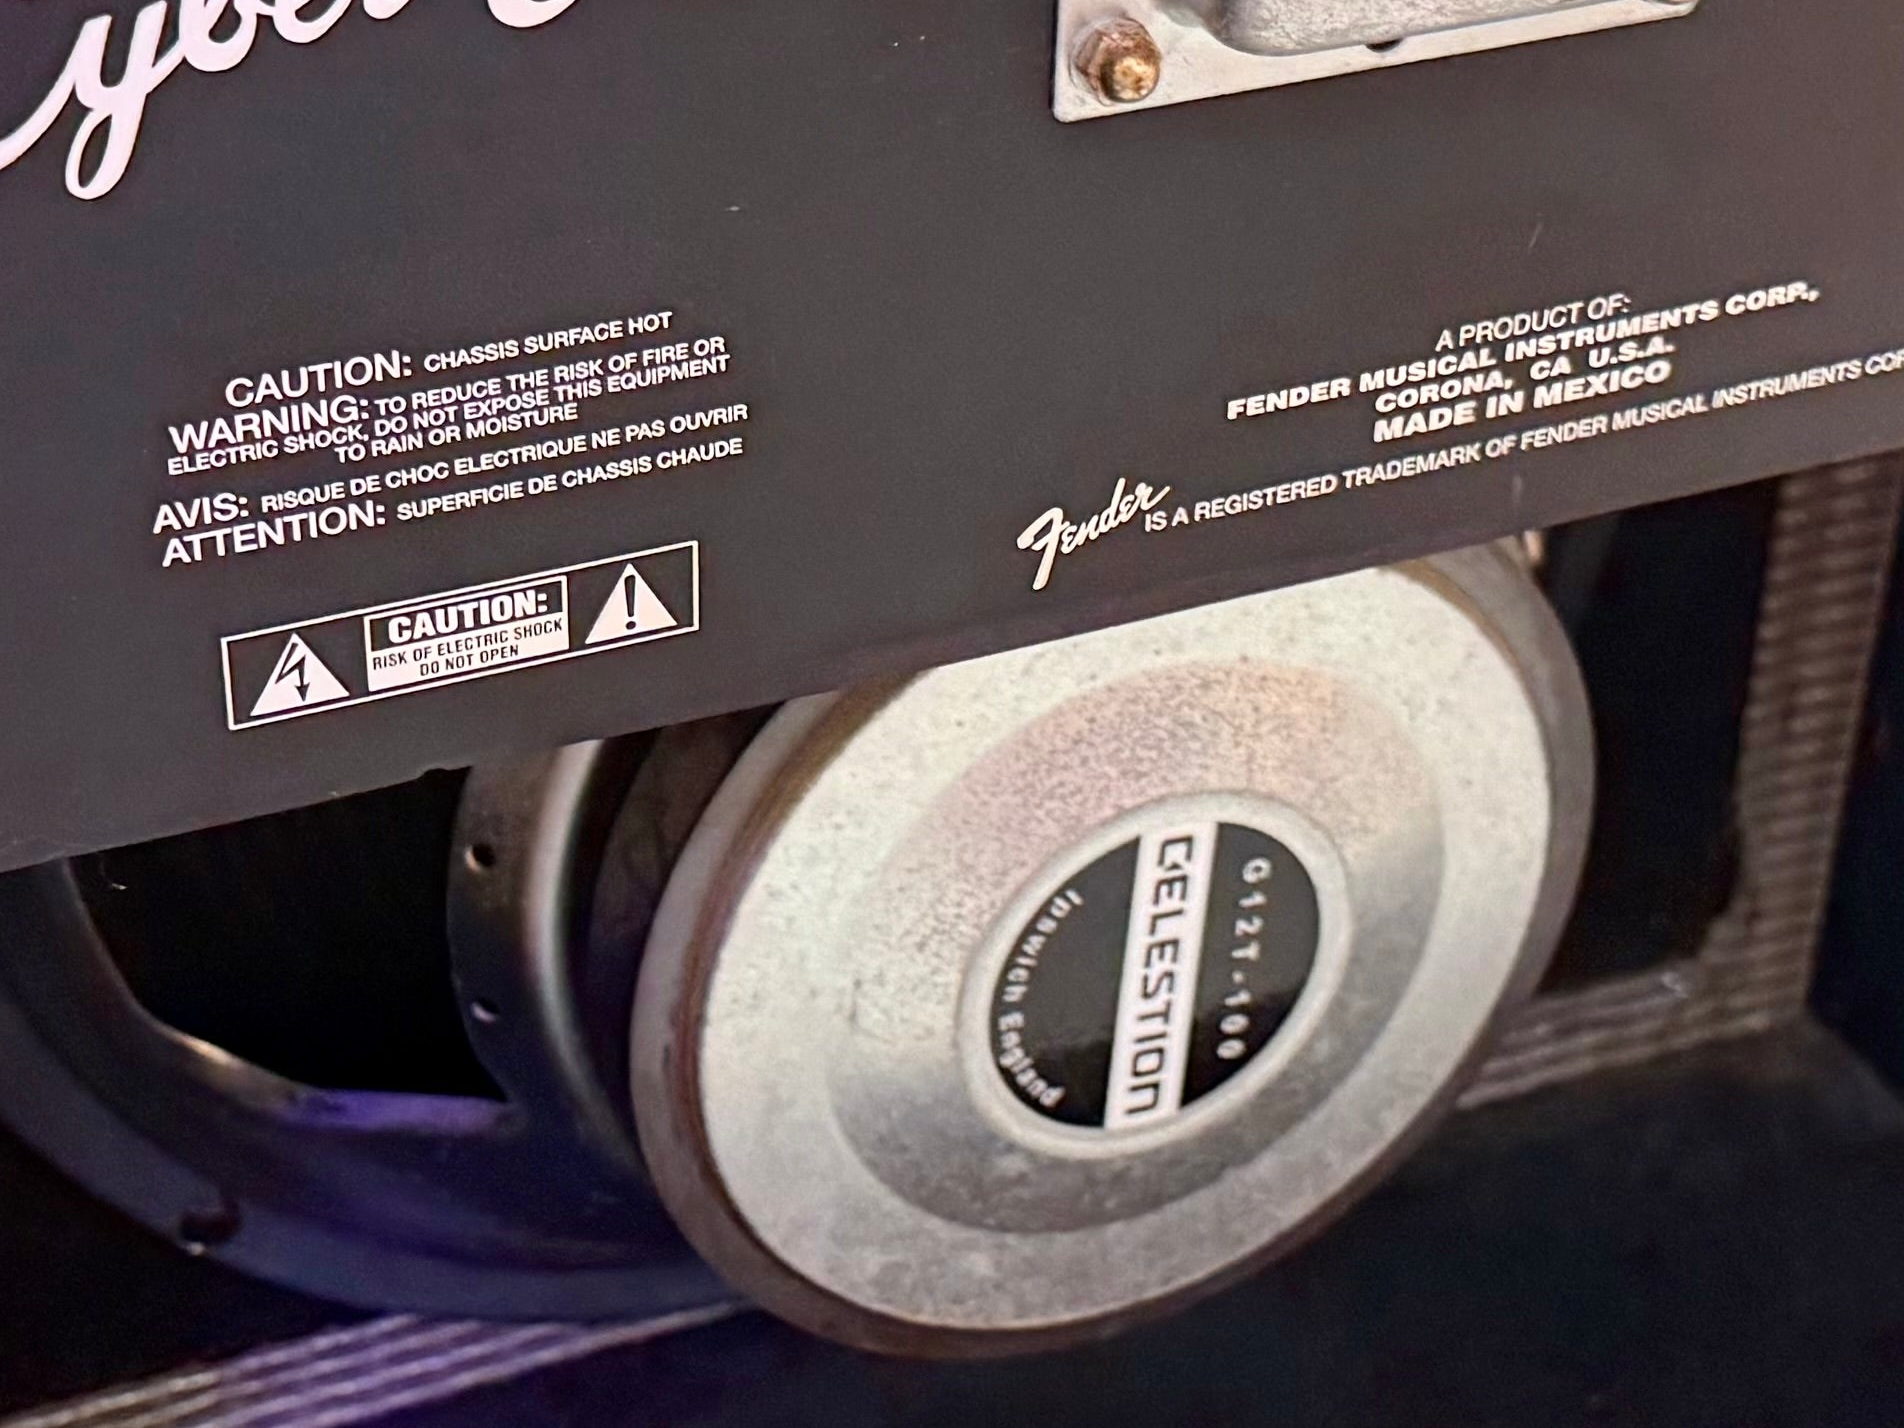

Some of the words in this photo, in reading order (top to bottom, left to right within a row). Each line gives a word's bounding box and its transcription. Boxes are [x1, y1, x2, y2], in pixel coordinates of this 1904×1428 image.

[223, 349, 413, 408] CAUTION:
[422, 337, 520, 373] CHASSIS
[522, 318, 624, 355] SURFACE
[626, 309, 673, 336] HOT
[1225, 376, 1352, 421] FENDER
[1357, 347, 1498, 393] MUSICAL
[1503, 301, 1720, 363] INSTRUMENTS
[1373, 368, 1514, 413] CORONA,
[1528, 354, 1572, 381] CA
[1587, 334, 1676, 369] U.S.A.
[1434, 328, 1455, 353] A
[1457, 302, 1585, 348] PRODUCT
[1585, 294, 1632, 321] OF:
[166, 396, 370, 454] WARNING:
[372, 394, 408, 417] TO
[409, 376, 502, 411] REDUCE
[503, 367, 550, 393] THE
[552, 357, 605, 384] RISK
[606, 350, 639, 374] OF
[640, 341, 690, 368] FIRE
[691, 334, 726, 357] OR
[166, 437, 279, 476] ELECTRIC
[281, 421, 370, 454] SHOCK,
[372, 413, 409, 438] DO
[411, 403, 459, 431] NOT
[461, 386, 551, 421] EXPOSE
[551, 377, 603, 403] THIS
[605, 353, 731, 393] EQUIPMENT
[333, 442, 367, 464] TO
[369, 430, 424, 458] RAIN
[426, 423, 462, 447] OR
[464, 401, 579, 440] MOISTURE
[1372, 399, 1478, 443] MADE
[1484, 389, 1525, 419] IN
[1531, 360, 1672, 409] MEXICO
[151, 492, 250, 535] AVIS:
[259, 480, 346, 514] RISQUE
[348, 473, 383, 497] DE
[383, 460, 450, 489] CHOC
[452, 433, 588, 476] ELECTRIQUE
[589, 426, 621, 450] NE
[623, 418, 666, 443] PAS
[667, 403, 749, 434] OUVRIR
[161, 501, 386, 568] ATTENTION:
[395, 479, 525, 521] SUPERFICIE
[526, 472, 559, 495] DE
[559, 454, 653, 488] CHASSIS
[654, 436, 744, 470] CHAUDE
[1016, 477, 1170, 590] Fender
[1143, 509, 1168, 533] IS
[1169, 505, 1190, 527] A
[1192, 472, 1339, 522] REGISTERED
[1340, 440, 1482, 489] TRADEMARK
[1483, 433, 1518, 459] OF
[1518, 413, 1609, 451] FENDER
[1610, 392, 1709, 431] MUSICAL
[1710, 358, 1863, 409] INSTRUMENTS
[371, 649, 408, 671] RISK
[411, 644, 432, 663] OF
[435, 628, 509, 657] ELECTRIC
[512, 617, 563, 641] SHOCK
[386, 588, 549, 644] CAUTION:
[418, 659, 440, 677] DO
[443, 652, 474, 671] NOT
[478, 644, 519, 664] OPEN
[1001, 888, 1084, 1004] Ipswich
[1124, 835, 1193, 1115] CELESTION
[1216, 857, 1271, 1059] G12T-100
[998, 1011, 1066, 1108] England
